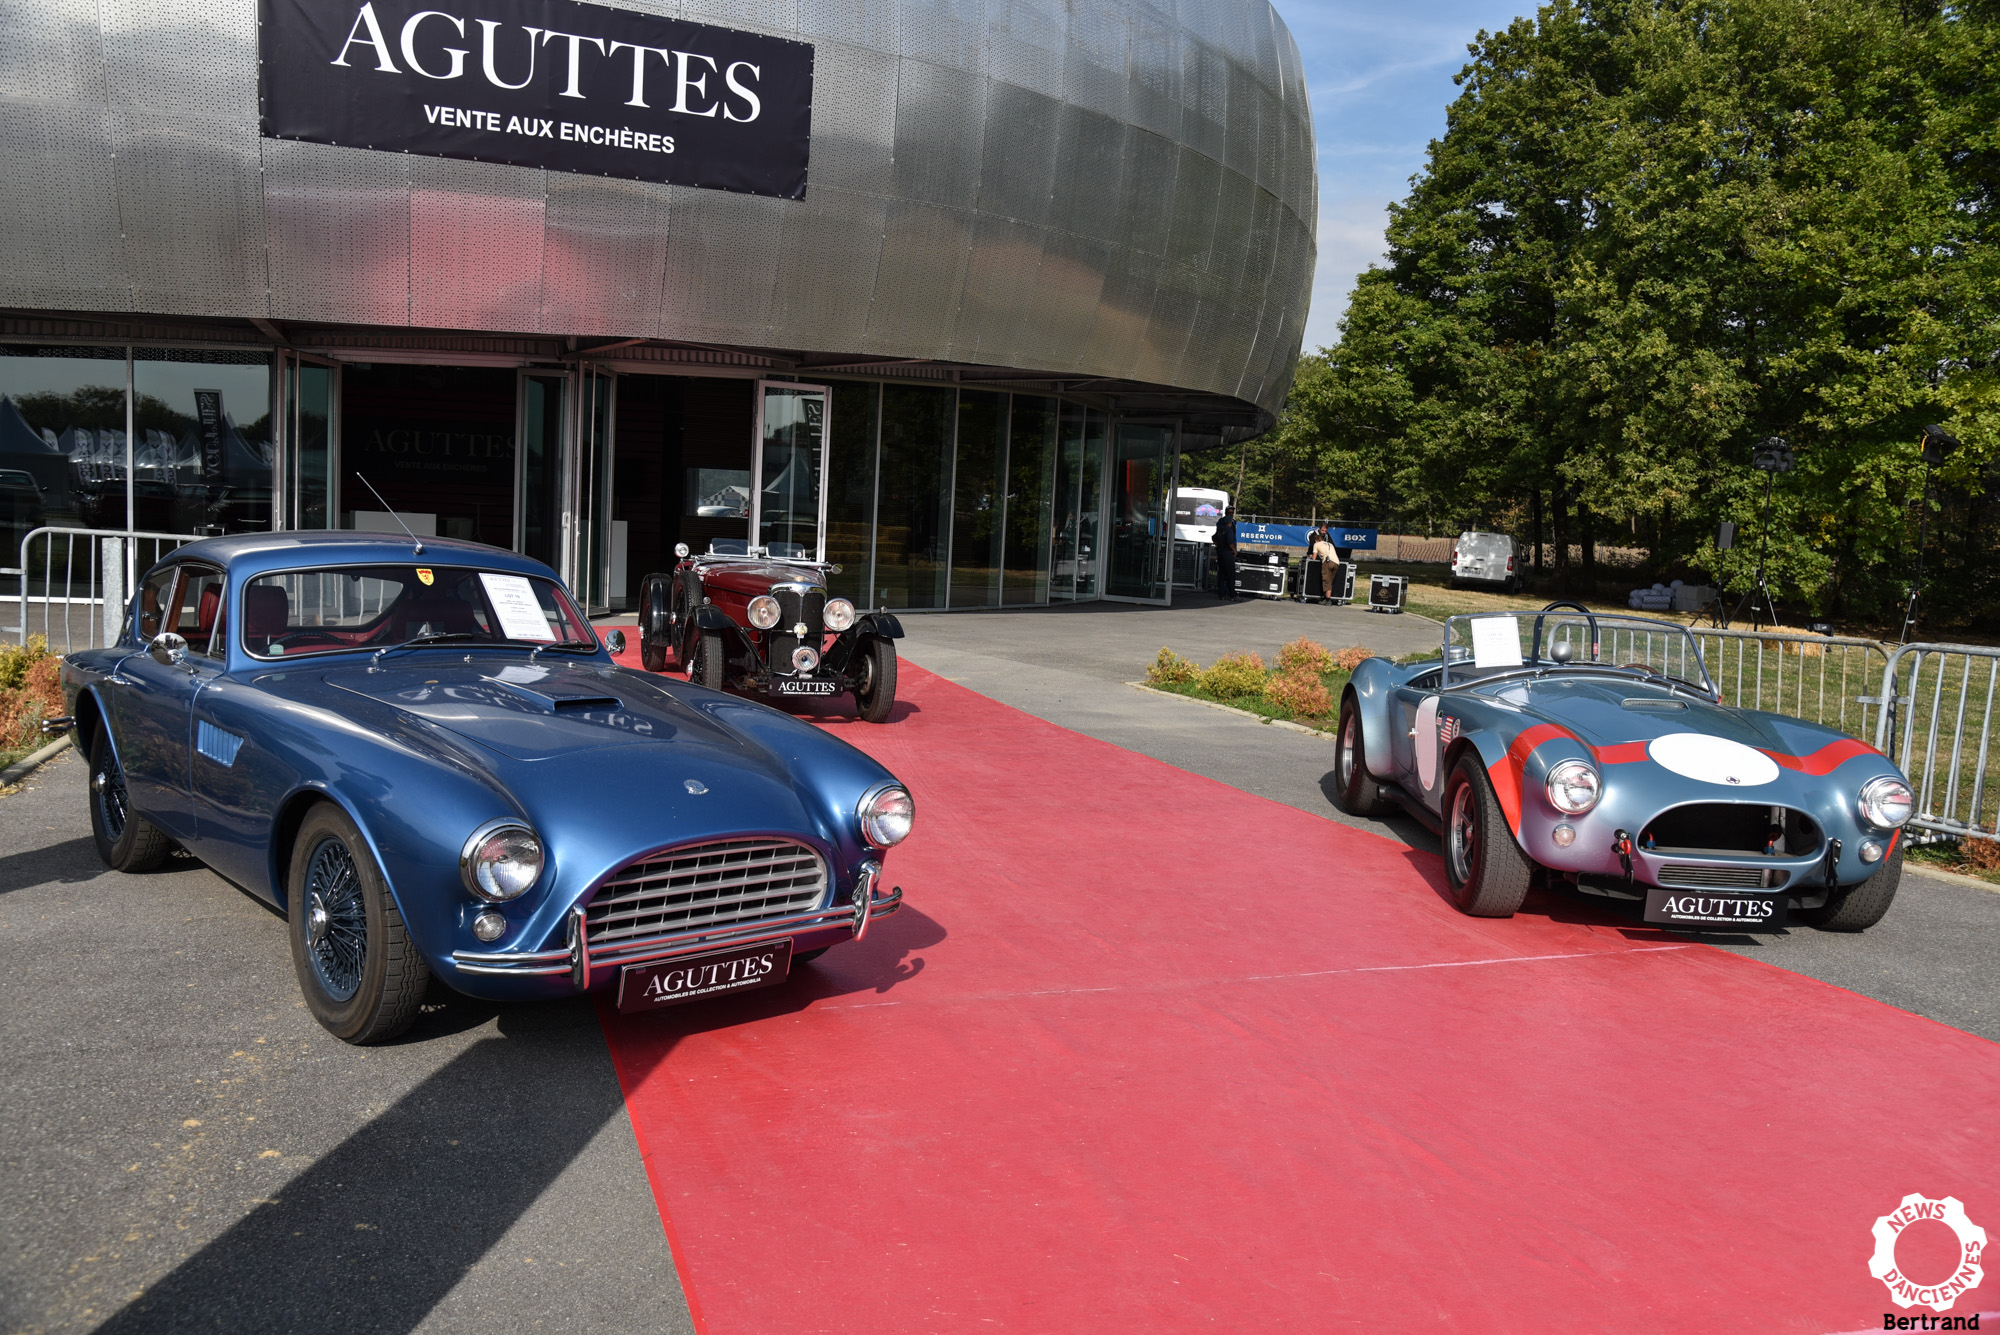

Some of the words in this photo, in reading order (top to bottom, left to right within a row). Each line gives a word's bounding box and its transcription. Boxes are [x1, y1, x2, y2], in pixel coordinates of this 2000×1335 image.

[330, 1, 762, 123] AGUTTES
[424, 104, 501, 132] VENTE
[506, 115, 553, 138] AUX
[560, 119, 675, 154] ENCHÈRES
[365, 428, 515, 458] AGUTTES
[394, 460, 422, 469] VENTE
[423, 462, 441, 470] AUX
[1240, 532, 1283, 541] RESERVOIR
[778, 681, 836, 692] AGUTTES
[1661, 896, 1774, 917] AGUTTES
[643, 953, 774, 997] AGUTTES
[654, 991, 689, 1002] AUTOMOBILES
[697, 984, 726, 994] COLLECTION
[731, 977, 761, 988] AUTOMOBILIA
